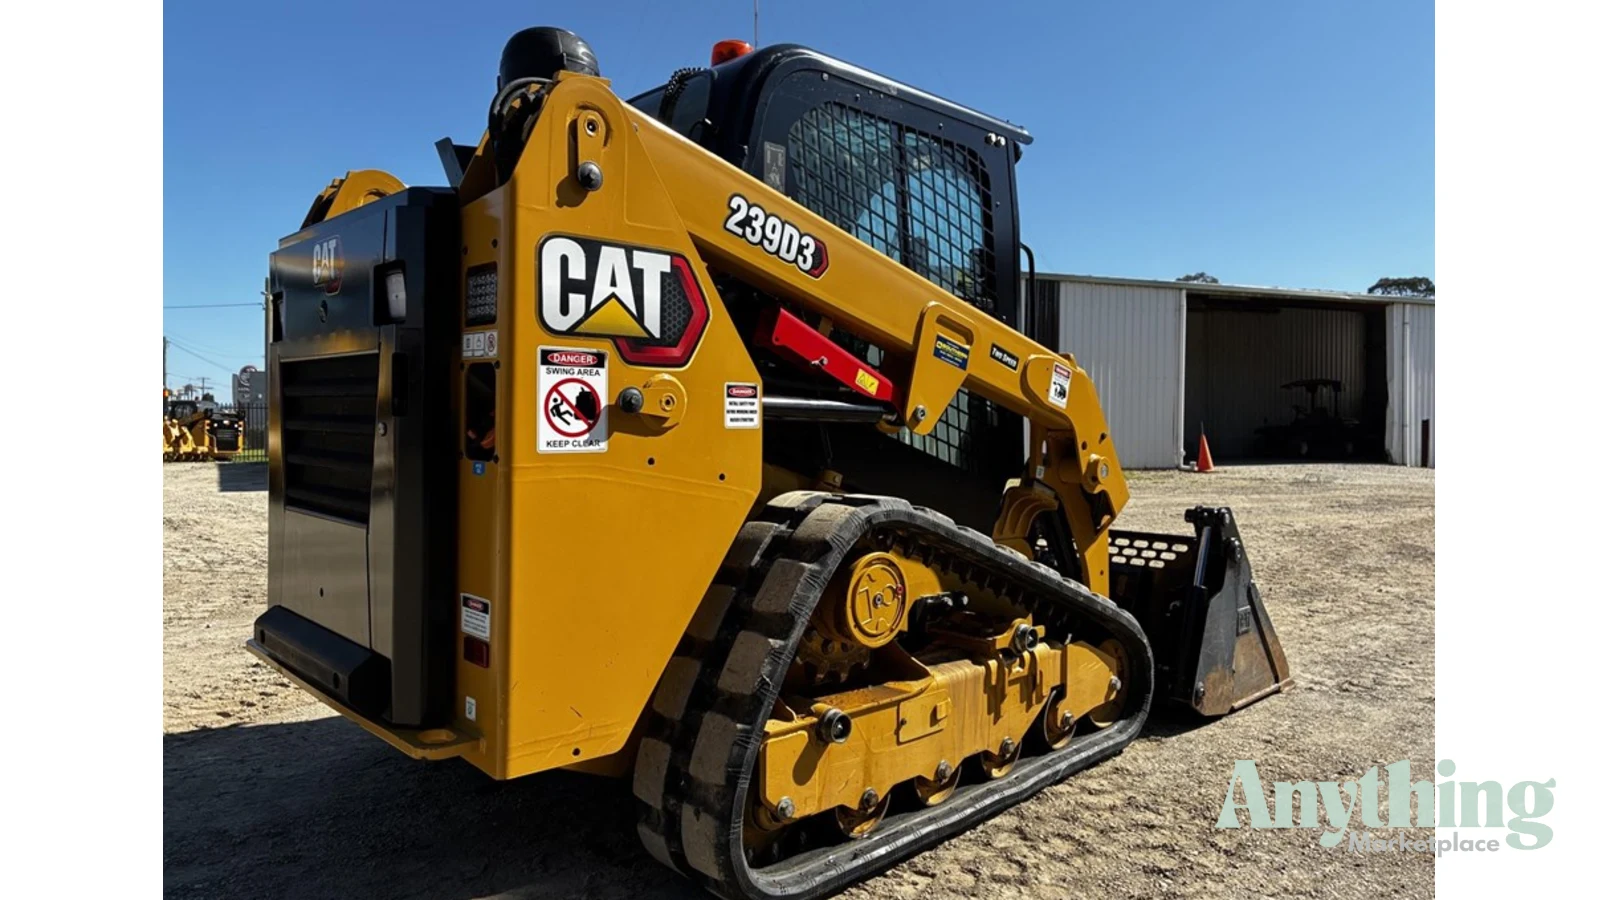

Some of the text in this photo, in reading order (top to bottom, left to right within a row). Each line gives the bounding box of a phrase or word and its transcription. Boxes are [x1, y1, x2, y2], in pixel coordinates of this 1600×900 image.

[725, 195, 816, 271] 239D3
[313, 239, 336, 284] CAT
[541, 237, 671, 339] CAT
[546, 367, 601, 377] SWING AREA
[553, 353, 593, 364] DANGER
[546, 439, 601, 448] KEEP CLEAR
